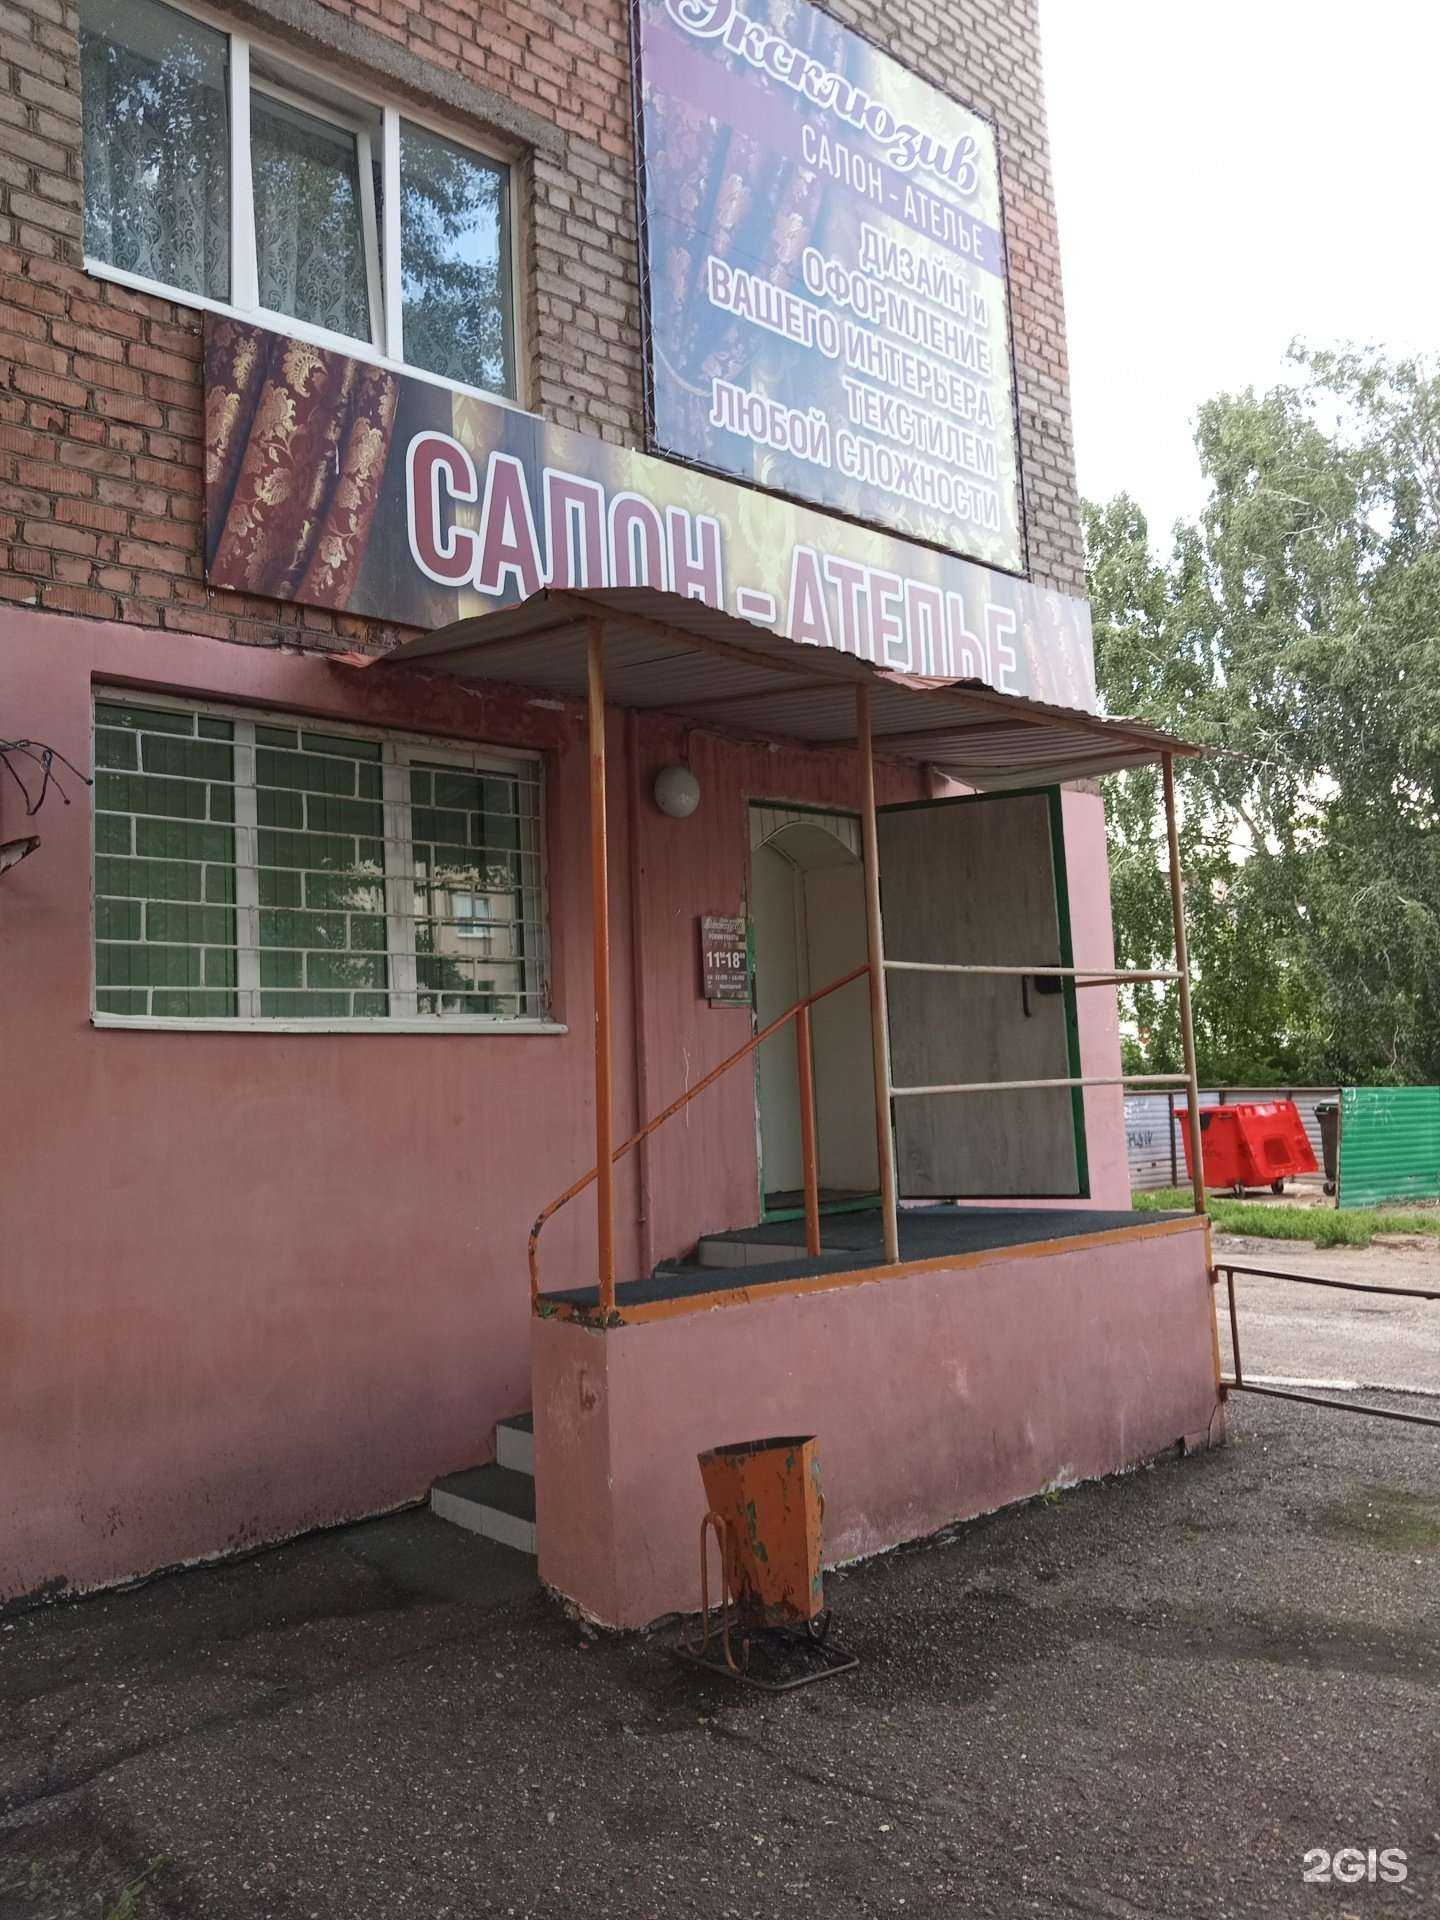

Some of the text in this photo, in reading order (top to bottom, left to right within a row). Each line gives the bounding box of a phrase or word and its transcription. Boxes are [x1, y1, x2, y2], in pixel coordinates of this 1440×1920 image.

[801, 125, 882, 201] САЛОН
[903, 195, 985, 261] АТЕЛЬЕ
[803, 247, 991, 377] ОФОРМЛЕНИЕ
[860, 221, 967, 319] ДИЗАЙН
[708, 256, 994, 429] ВАШЕГО ИНТЕРЬЕРА
[709, 376, 998, 530] ЛЮБОЙ СЛОЖНОСТИ
[843, 376, 996, 480] ТЕКСТИЛЕМ
[406, 430, 723, 610] САЛОН
[787, 544, 1022, 696] АТЕЛЬЕ
